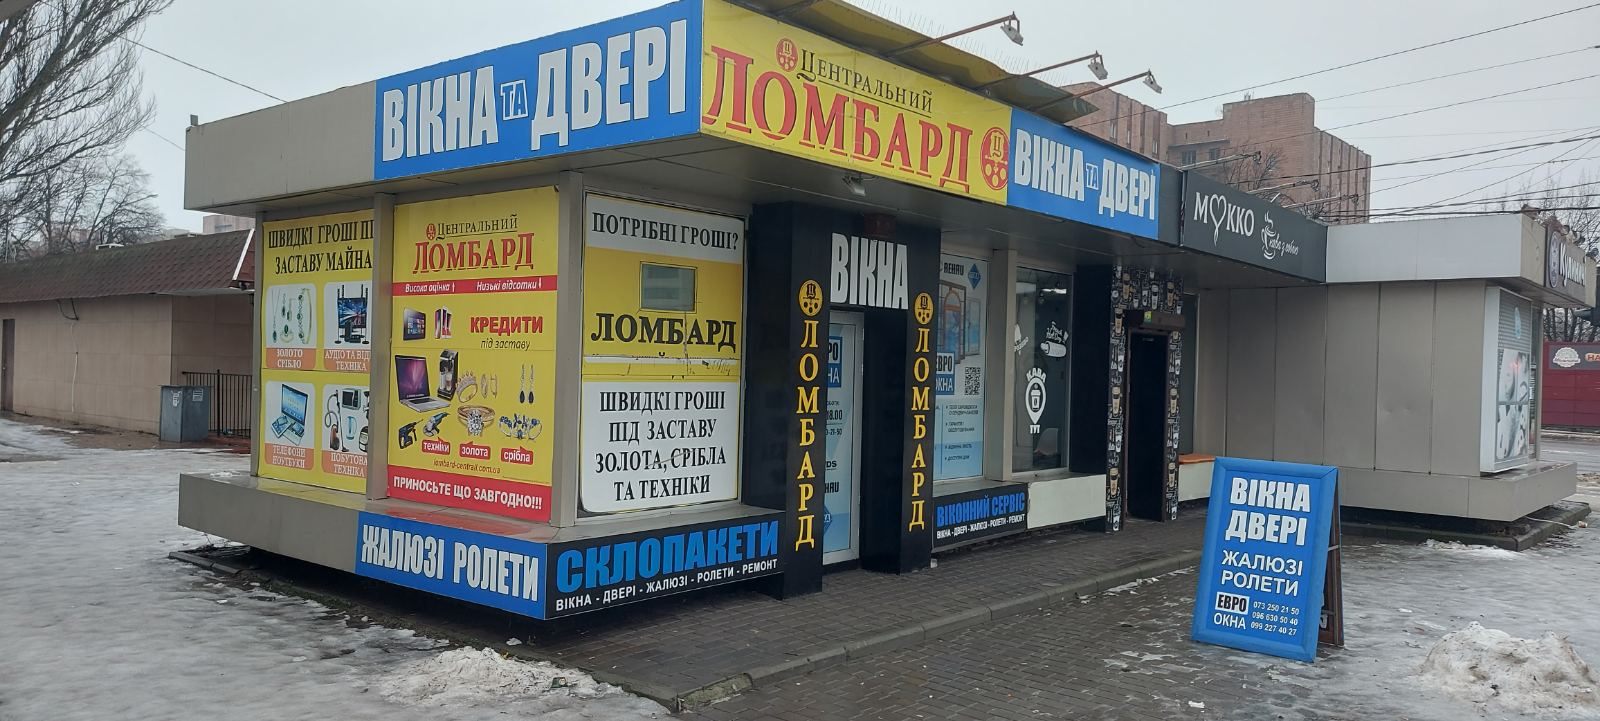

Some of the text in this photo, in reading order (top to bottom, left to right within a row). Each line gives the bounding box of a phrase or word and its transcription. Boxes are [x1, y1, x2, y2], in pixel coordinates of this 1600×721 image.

[382, 19, 687, 162] ВІКНА ТА ДВЕРІ
[702, 45, 973, 193] ЛОМБАРД
[1014, 128, 1156, 221] ВІКНА ТА ДВЕРІ
[268, 220, 374, 250] ШВИДКІ ГРОШІ ПІ
[592, 212, 739, 250] ПОТРІБНІ ГРОШІ?
[275, 246, 373, 274] ЗАСТАВУ МАЙНА
[412, 232, 535, 275] ЛОМБАРД
[830, 232, 909, 310] ВІКНА
[943, 262, 964, 276] REHAU
[405, 282, 451, 294] Висока оцінка
[476, 279, 537, 292] Низькі відсотки
[470, 316, 544, 336] КРЕДИТИ
[590, 313, 737, 354] ЛОМБАРД
[276, 348, 303, 358] ЗОЛОТО
[325, 350, 345, 360] АУДІО
[346, 350, 356, 360] ТА
[480, 338, 530, 352] під заставу
[277, 359, 302, 369] СРІБЛО
[335, 361, 367, 371] ТЕХНІКА
[1026, 367, 1046, 383] КАВА
[599, 391, 726, 416] ШВИДКІ ГРОШІ
[608, 418, 717, 446] ПІД ЗАСТАВУ
[795, 320, 819, 551] ЛОМБАРД
[909, 328, 931, 533] ЛОМБАРД
[423, 440, 450, 453] техніки
[461, 446, 489, 458] золота
[503, 450, 531, 463] срібла
[272, 455, 305, 468] НОУТБУКИ
[333, 464, 365, 477] ТЕХНІКА
[595, 446, 727, 474] ЗОЛОТА, СРІБЛА
[393, 476, 543, 510] ПРИНОСЬТЕ ЩО ЗАВГОДНО!!!
[613, 474, 711, 502] ТА ТЕХНІКИ
[1230, 477, 1311, 513] ВІКНА
[936, 492, 1025, 528] ВІКОННИЙ СЕРВІС
[936, 514, 1025, 539] ВІКНА ДВЕРІ ЖАЛЮЗІ РОЛЕТИ РЕМОНТ
[1224, 509, 1308, 546] ДВЕРІ
[361, 525, 539, 602] ЖАЛЮЗІ РОЛЕТИ
[556, 520, 779, 594] СКЛОПАКЕТИ
[1221, 550, 1303, 576] ЖАЛЮЗІ
[556, 558, 778, 611] ВІКНА ДВЕРІ ЖАЛЮЗІ РОЛЕТИ РЕМОНТ
[1221, 570, 1299, 597] РОЛЕТИ
[1217, 594, 1247, 612] ЕВРО
[1253, 601, 1300, 616] 073 250 21 50
[1213, 612, 1246, 630] ОКНА
[1250, 621, 1297, 636] 099 227 40 27
[1252, 611, 1299, 626] 096 630 50 40
